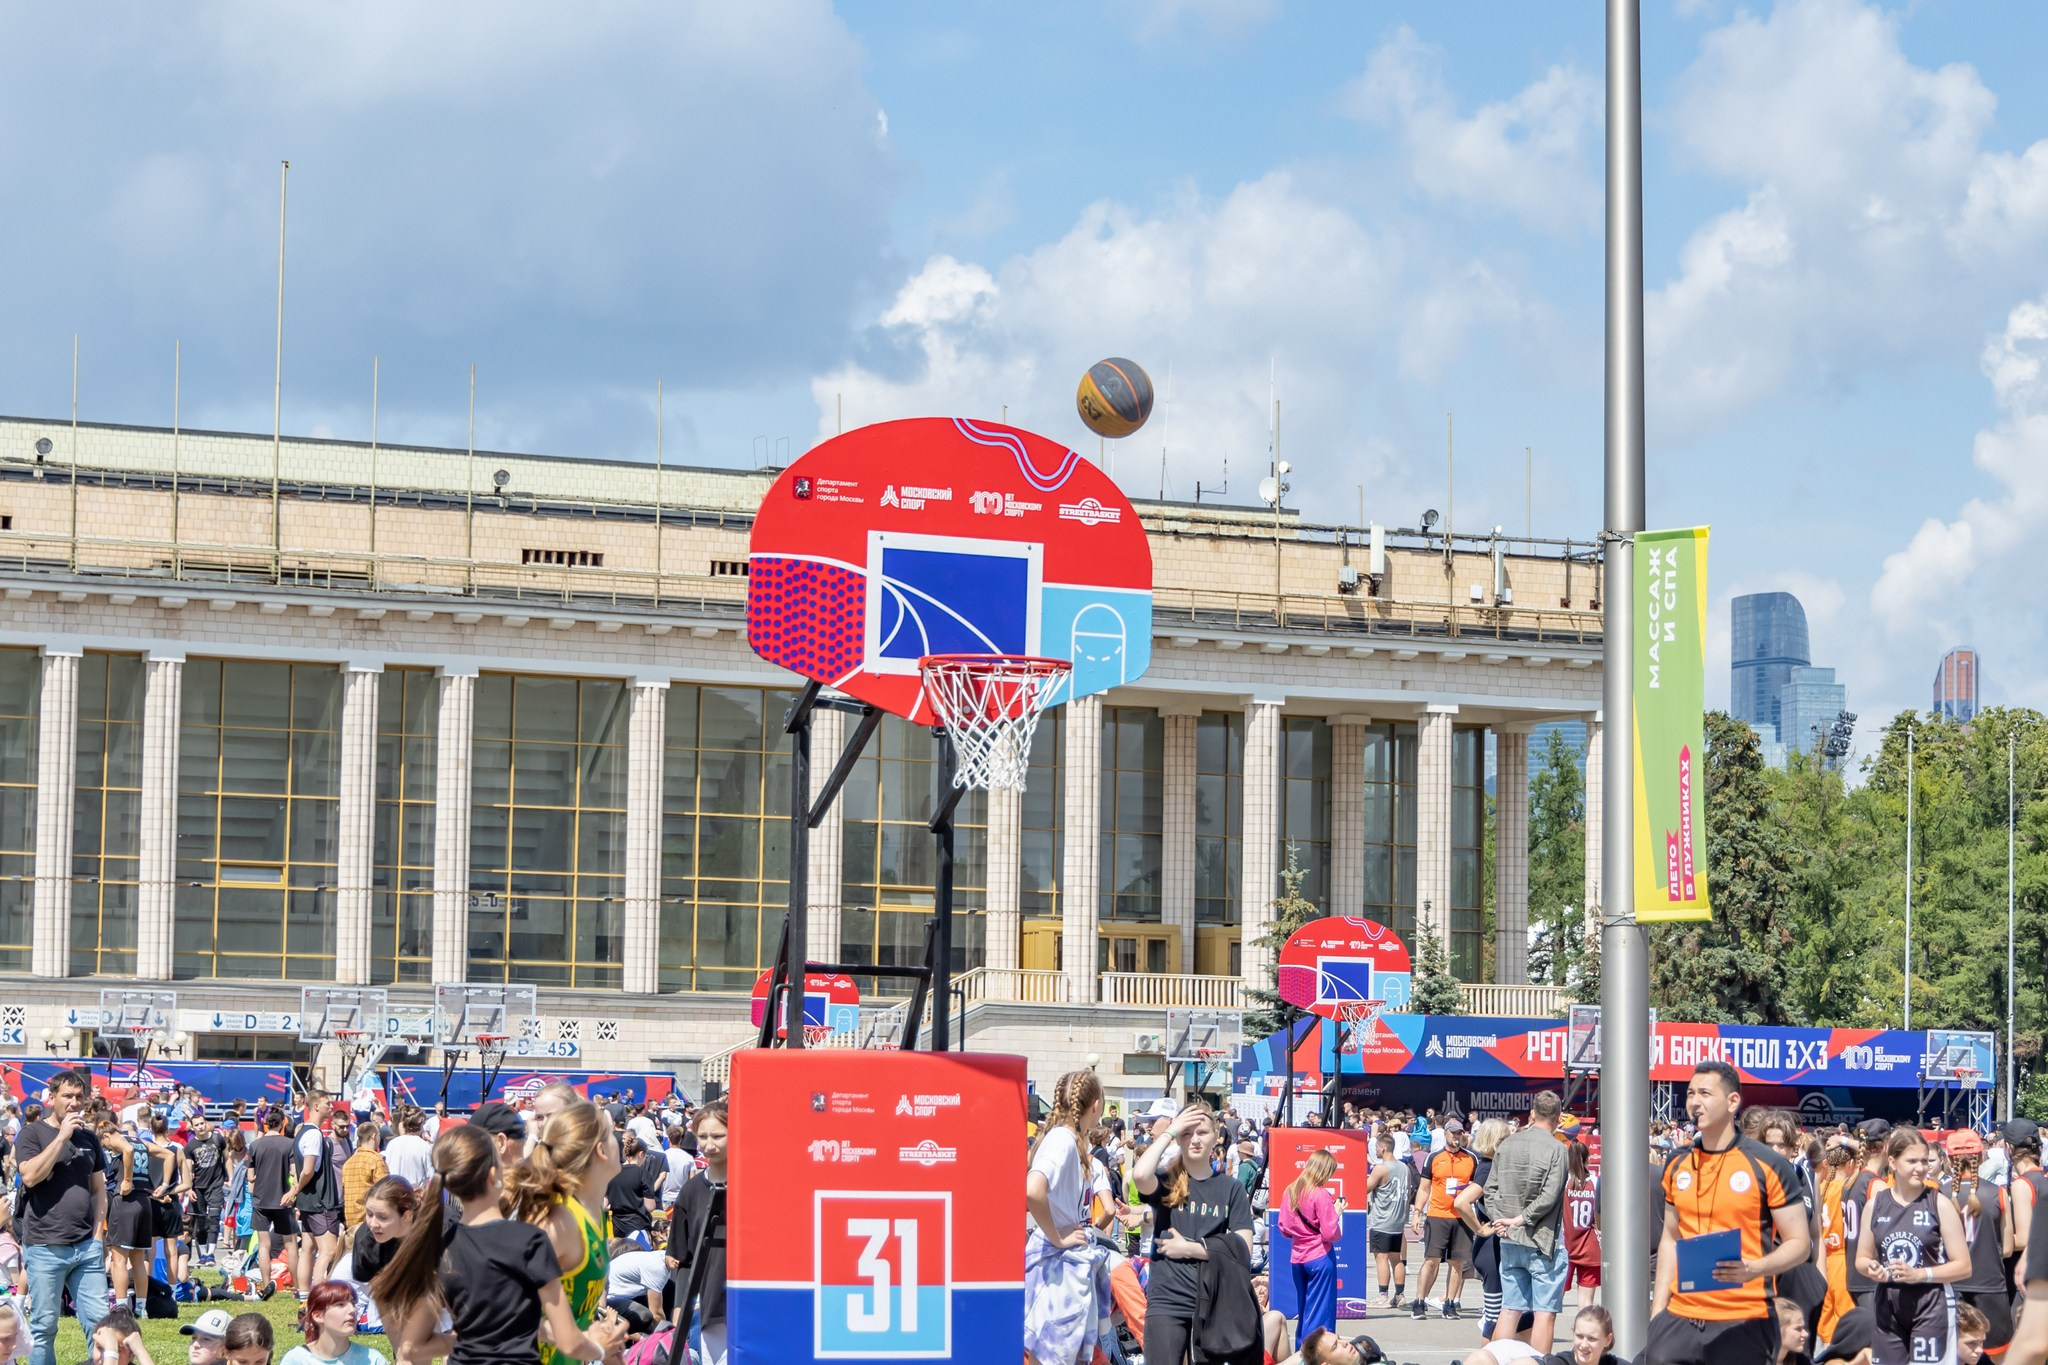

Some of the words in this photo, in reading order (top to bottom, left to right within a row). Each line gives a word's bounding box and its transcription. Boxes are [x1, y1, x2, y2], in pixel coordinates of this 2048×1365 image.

[816, 478, 858, 488] Департамент
[839, 495, 865, 503] Москвы
[901, 486, 953, 501] МОСКОВСКИЙ
[901, 498, 926, 511] СПОРТ
[968, 491, 1003, 516] 100
[1059, 507, 1121, 519] STREETBASKET
[1664, 545, 1679, 609] СПА
[1649, 546, 1662, 689] МАССАЖ
[1663, 621, 1676, 643] И
[1680, 758, 1694, 879] ЛУЖНИКАХ
[1668, 842, 1680, 897] ЛЕТО
[1685, 881, 1695, 896] В
[245, 1014, 257, 1029] D
[282, 1015, 292, 1030] 2
[1446, 1034, 1497, 1048] МОСКОВСКИЙ
[1446, 1047, 1471, 1059] СПОРТ
[1670, 1035, 1780, 1069] БАСКЕТБОЛ
[1839, 1045, 1873, 1070] 100
[831, 1092, 869, 1100] Департамент
[914, 1093, 961, 1106] МОСКОВСКИЙ
[1341, 1087, 1381, 1097] ртамент
[914, 1106, 936, 1117] СПОРТ
[807, 1139, 841, 1163] 100
[133, 1151, 149, 1175] 32
[1570, 1200, 1592, 1228] 18
[1913, 1210, 1930, 1226] 21
[1880, 1231, 1923, 1249] MOZHAISK
[846, 1218, 918, 1332] 31
[1913, 1336, 1939, 1362] 21
